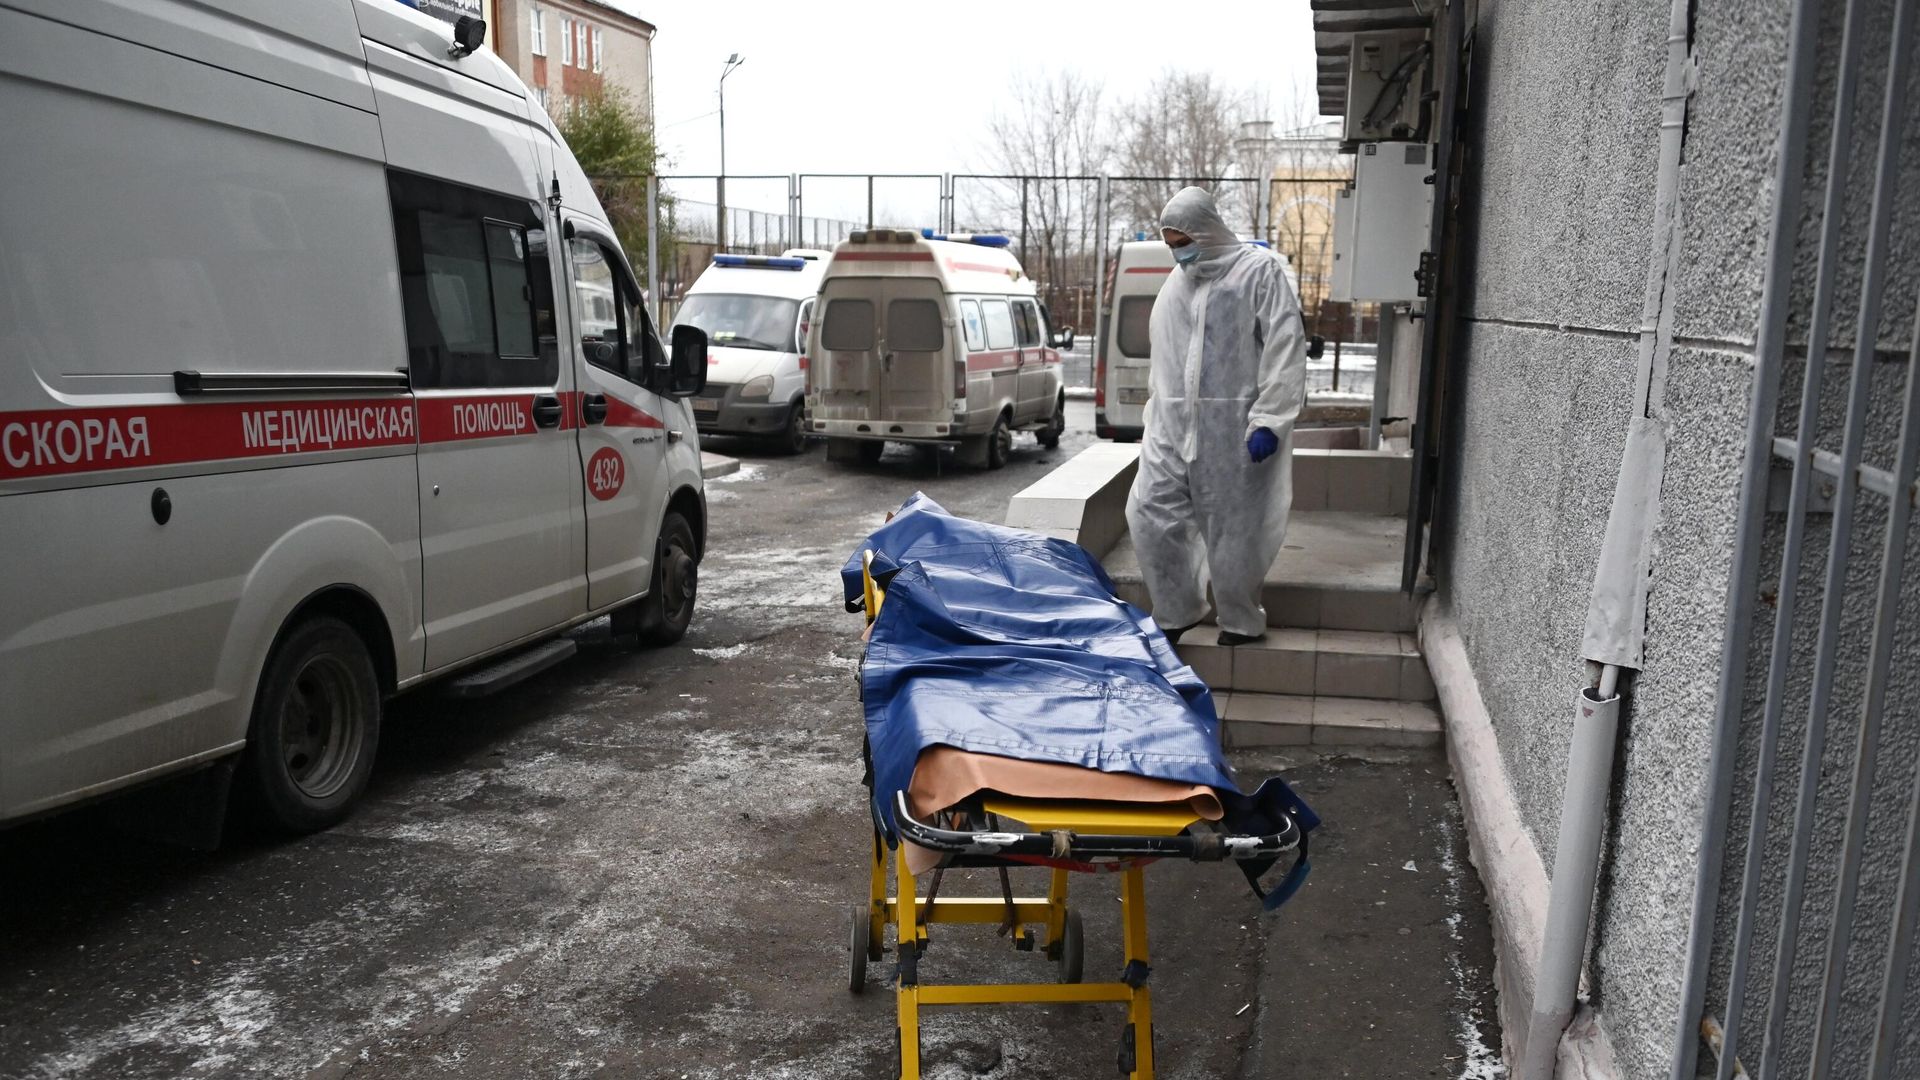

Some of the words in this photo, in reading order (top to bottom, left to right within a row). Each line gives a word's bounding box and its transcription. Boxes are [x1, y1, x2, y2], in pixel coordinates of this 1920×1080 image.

[2, 416, 150, 468] СКОРАЯ
[241, 405, 414, 452] МЕДИЦИНСКАЯ
[453, 401, 526, 435] ПОМОЩЬ
[593, 457, 619, 491] 432
